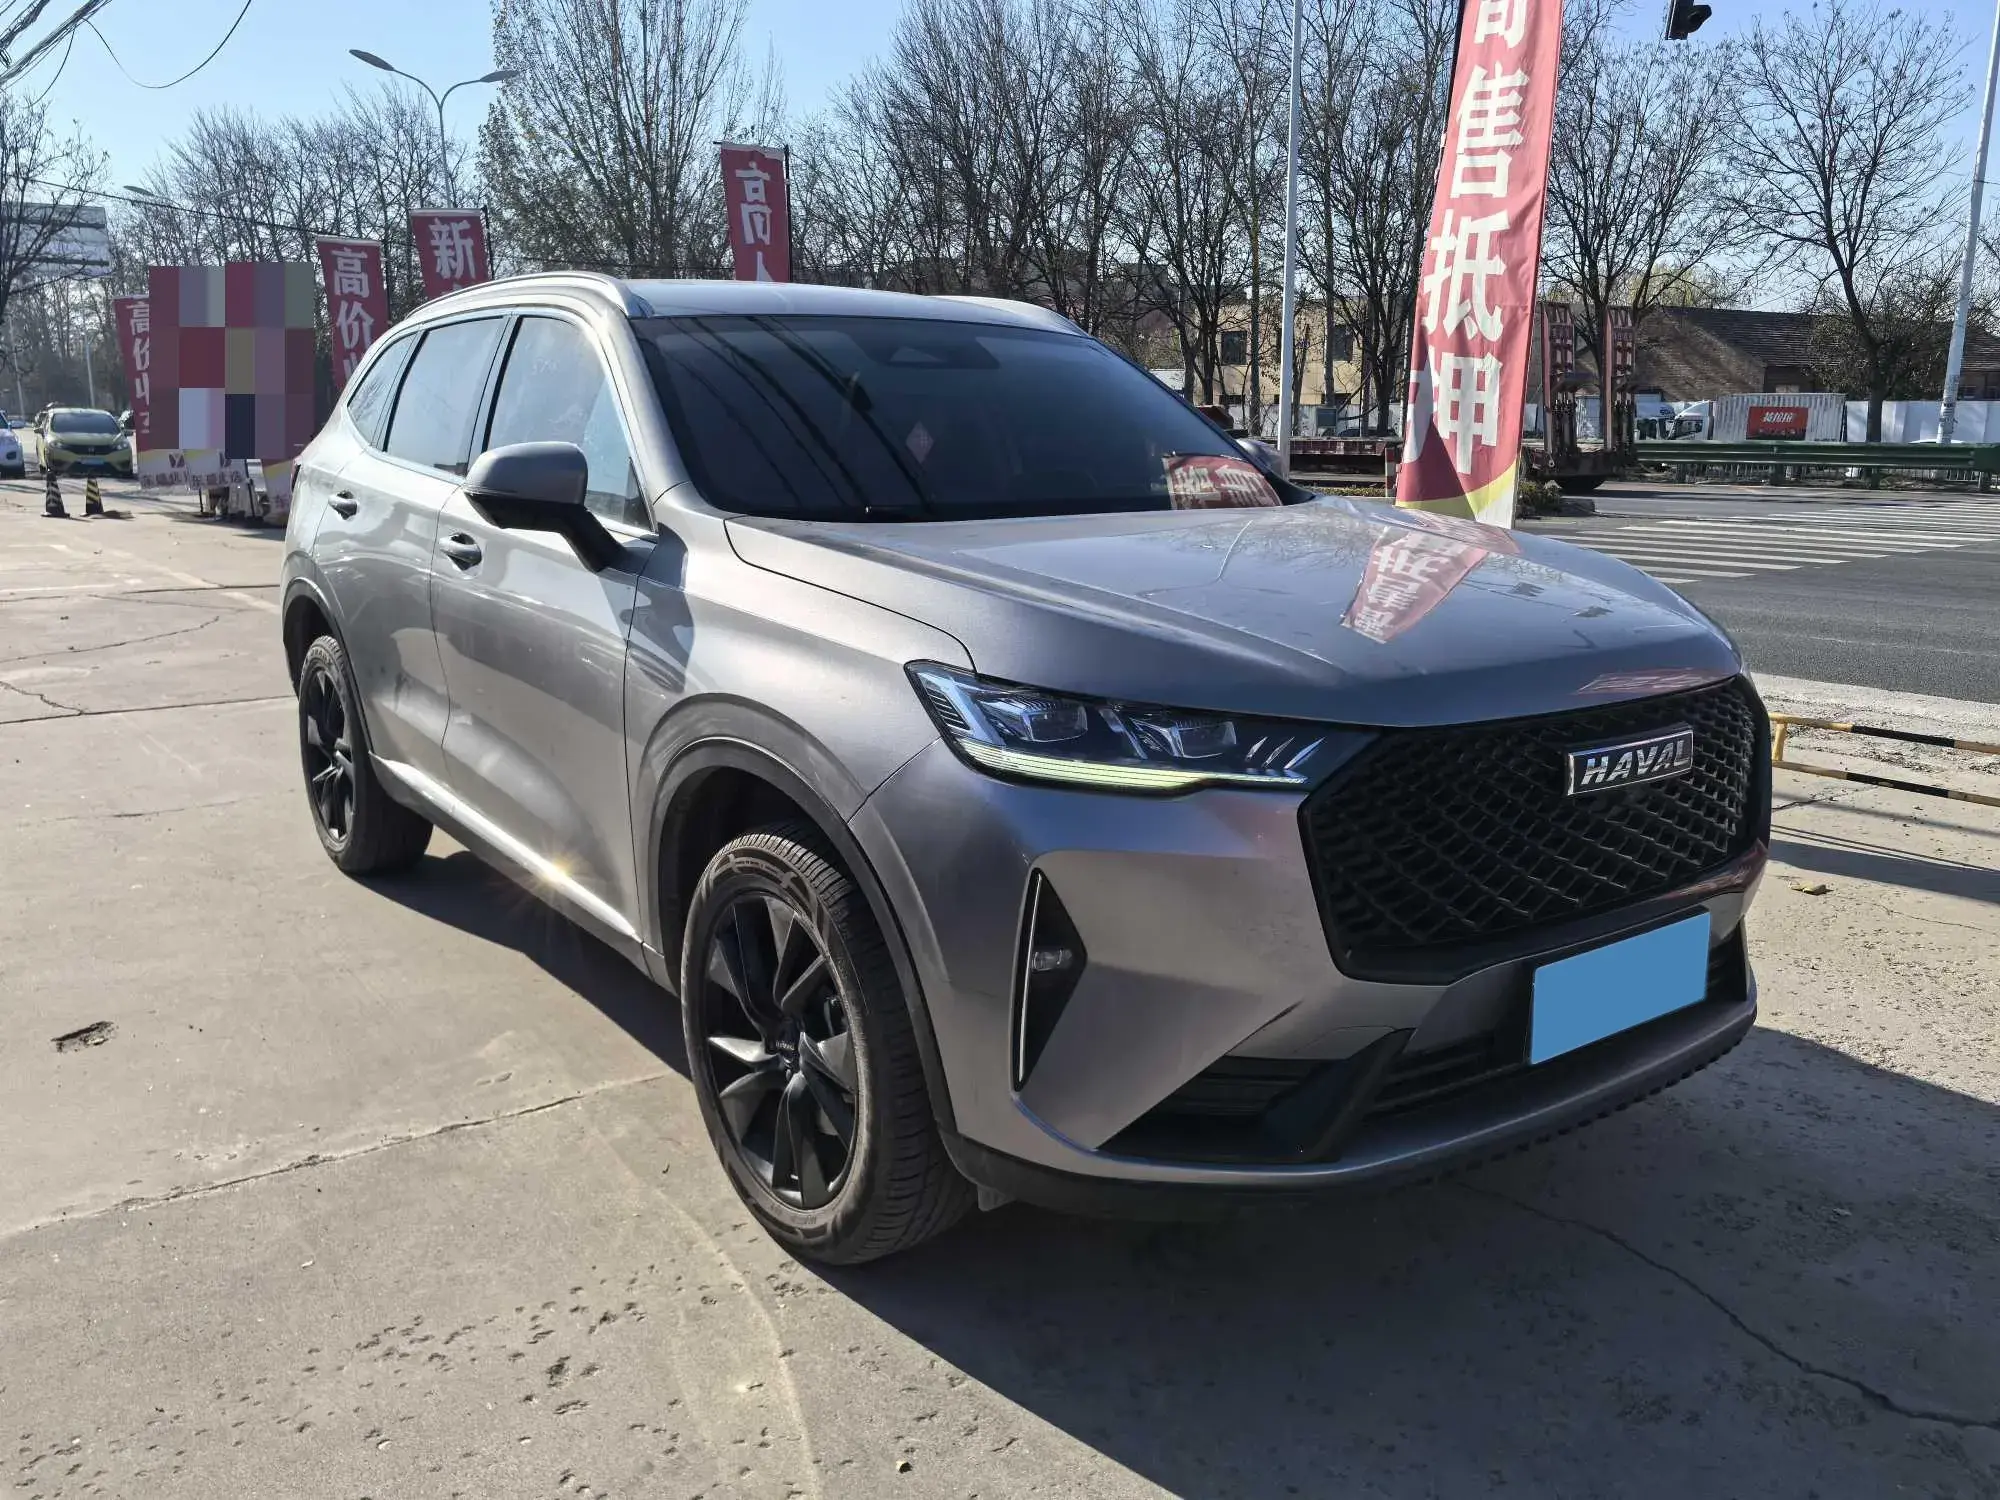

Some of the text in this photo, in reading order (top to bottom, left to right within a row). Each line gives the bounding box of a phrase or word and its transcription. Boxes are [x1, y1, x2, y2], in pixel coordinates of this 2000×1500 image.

[429, 217, 476, 296] 新
[331, 247, 375, 380] 高价
[1581, 739, 1691, 785] HAVAL
